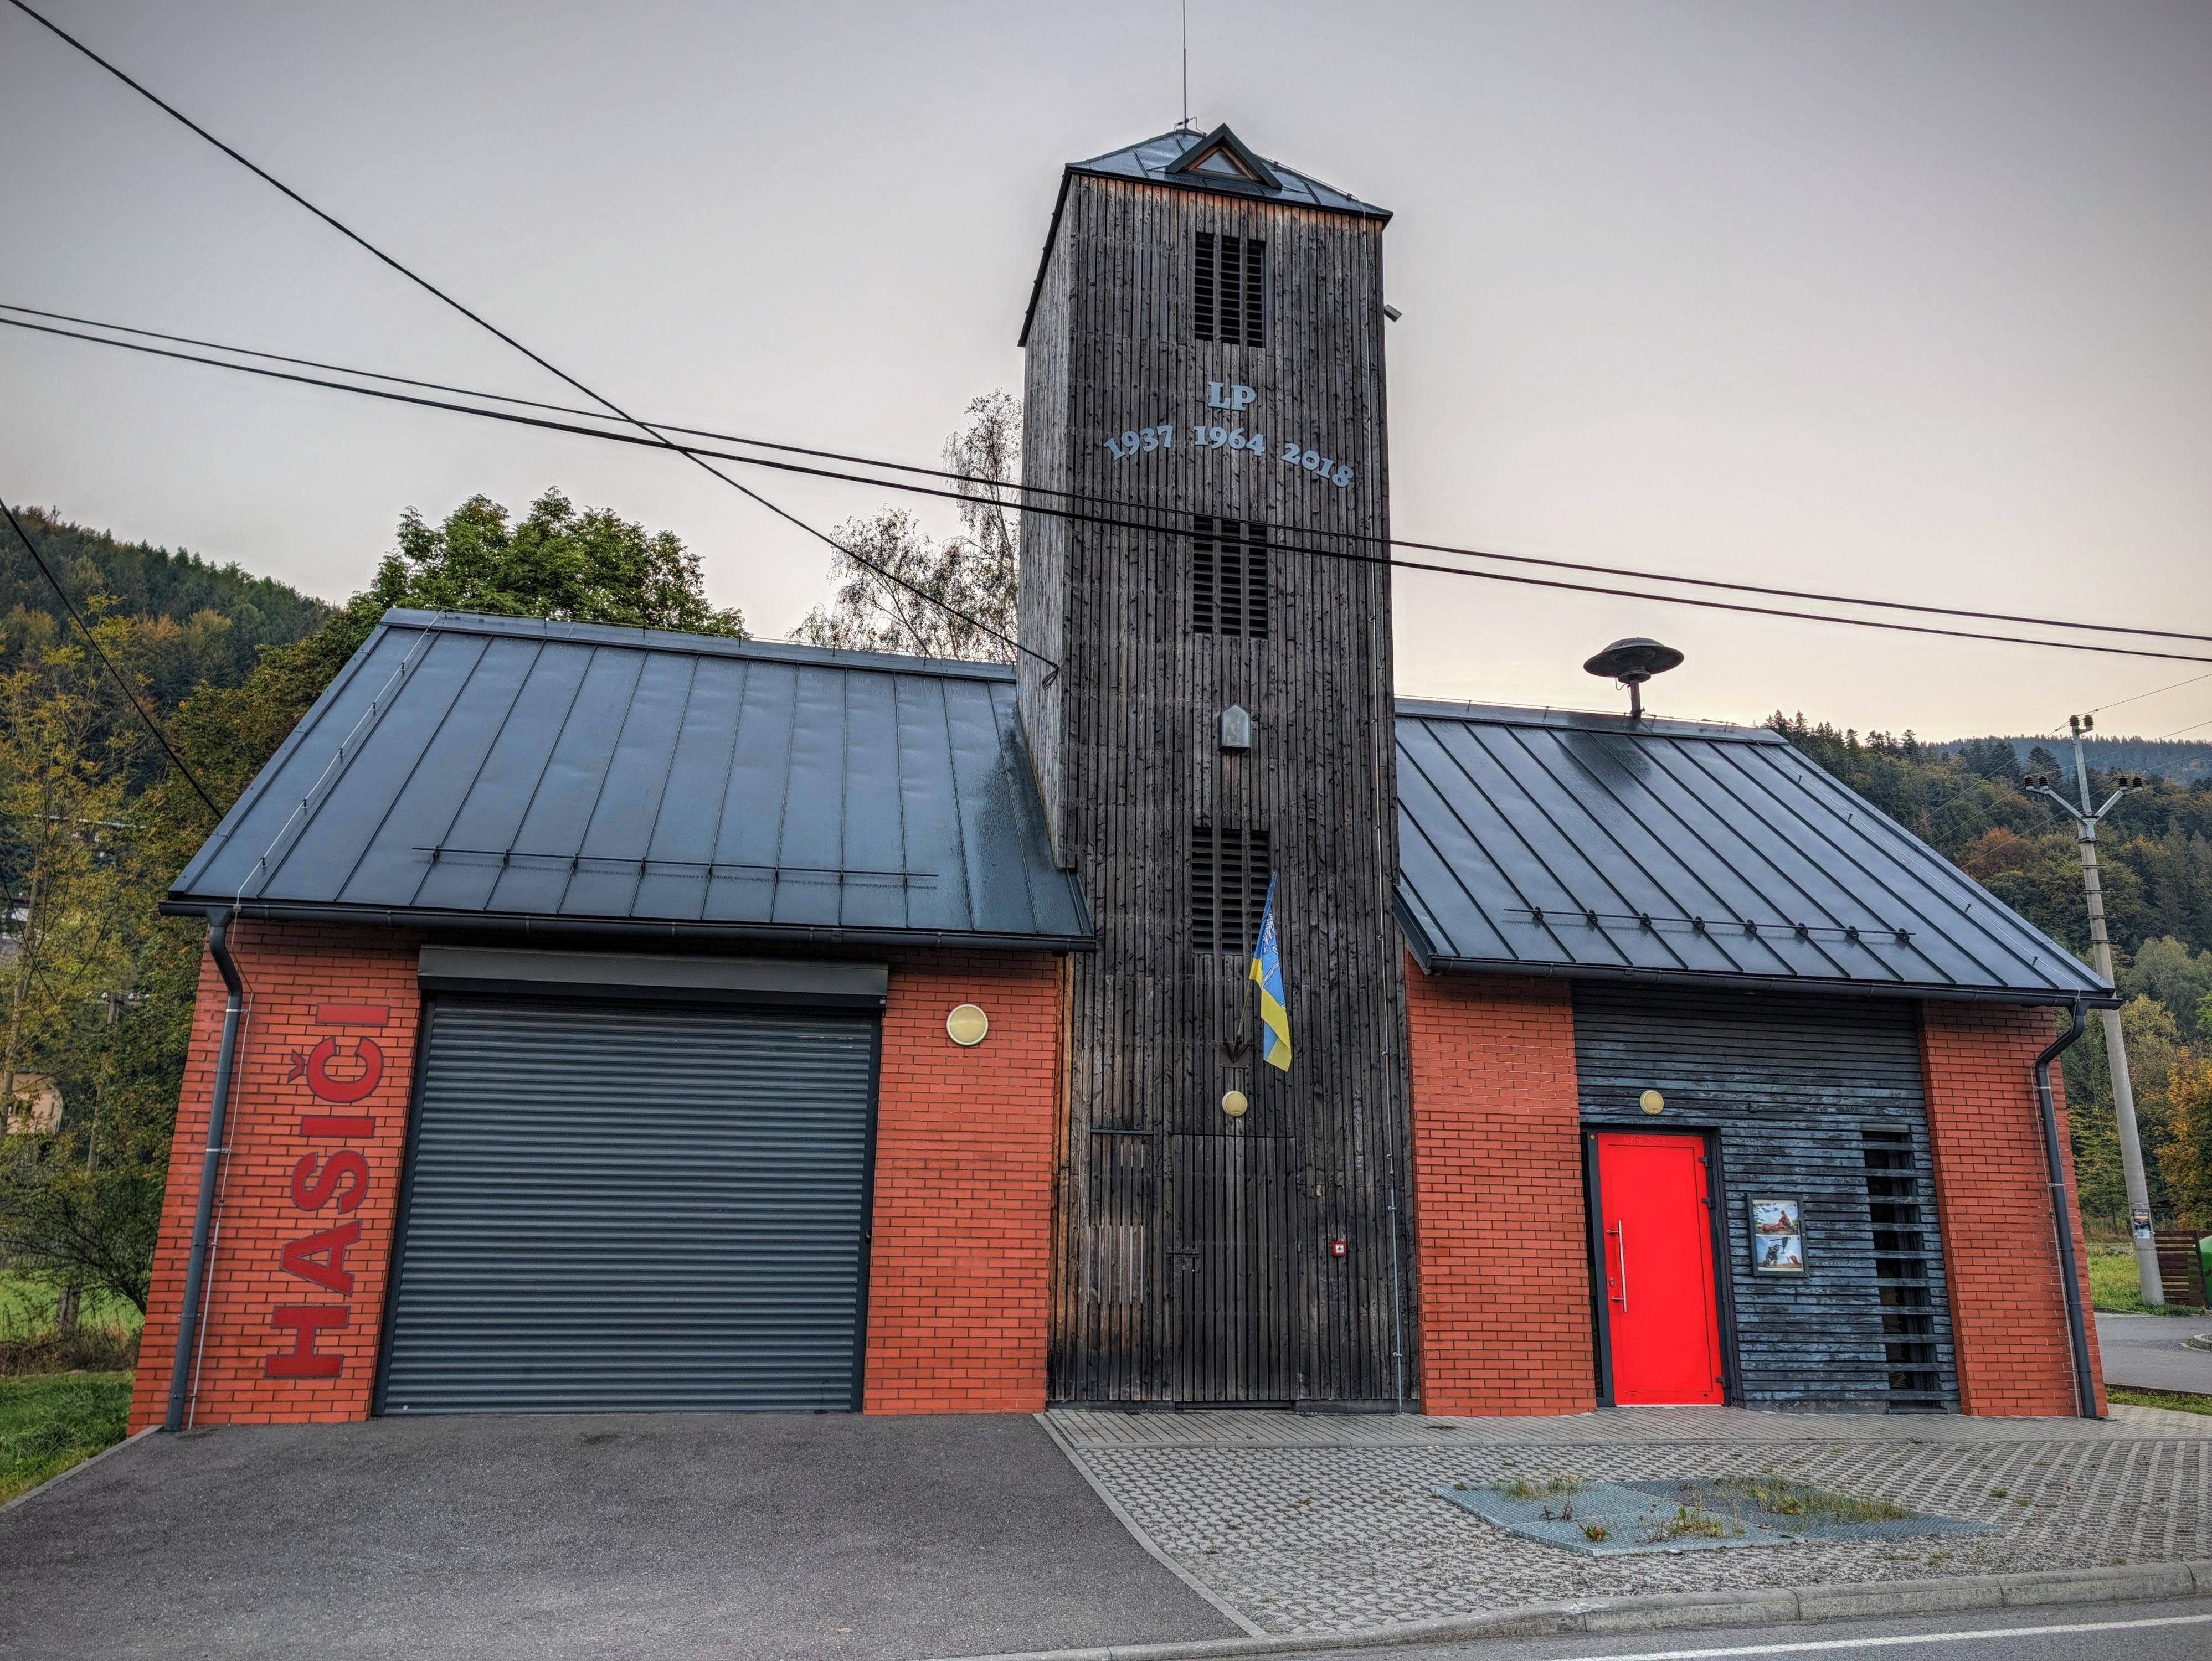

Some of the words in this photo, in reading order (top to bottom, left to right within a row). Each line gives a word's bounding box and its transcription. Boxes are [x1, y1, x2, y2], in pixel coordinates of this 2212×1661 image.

[1208, 381, 1256, 411] LP
[1104, 425, 1173, 461] 1937
[1194, 426, 1265, 456] 1964
[1281, 443, 1354, 487] 2018
[264, 1003, 390, 1378] HASIČI
